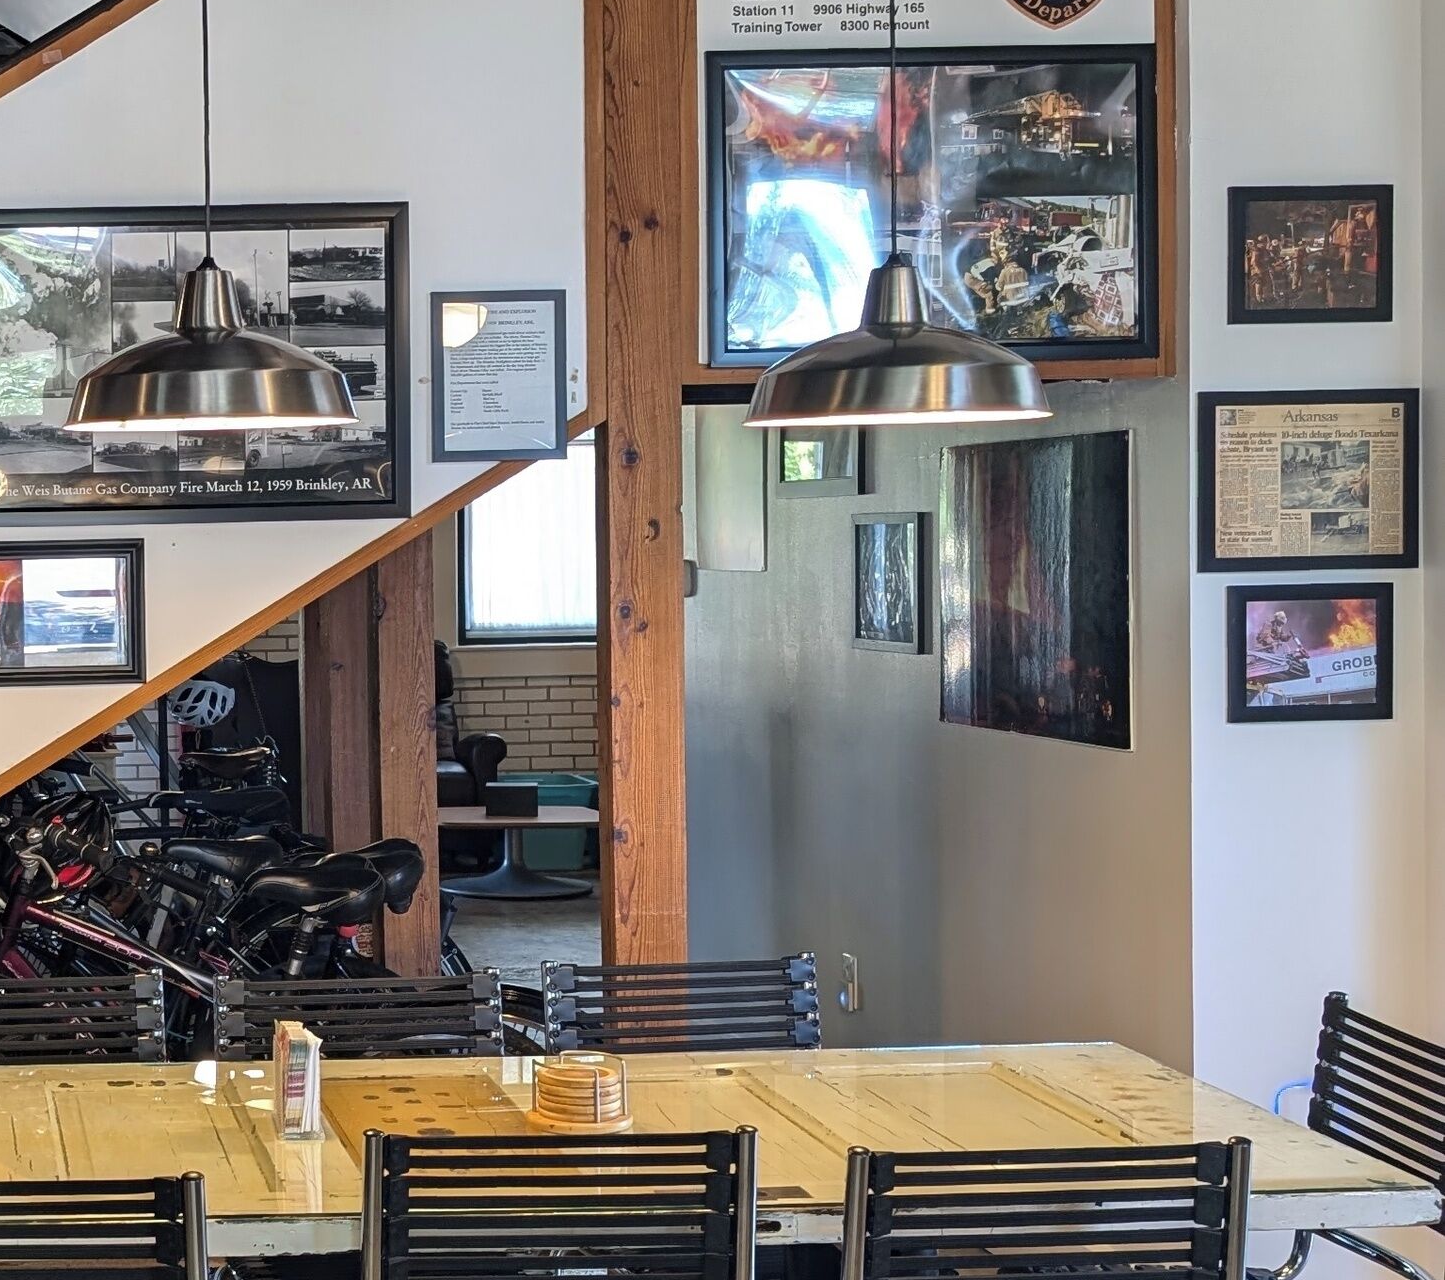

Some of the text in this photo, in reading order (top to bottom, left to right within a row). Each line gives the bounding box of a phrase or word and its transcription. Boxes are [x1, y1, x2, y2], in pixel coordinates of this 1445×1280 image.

[1282, 407, 1400, 423] Arkansas B
[1334, 429, 1358, 438] floods
[1359, 429, 1399, 438] Texarkana
[22, 484, 50, 497] Weis
[53, 484, 92, 496] Butane
[95, 483, 118, 496] Gas
[120, 482, 176, 497] Company
[180, 481, 203, 493] Fire
[206, 480, 243, 493] March
[246, 480, 263, 494] 12,
[267, 480, 293, 492] 1959
[296, 478, 349, 494] Brinkley,
[351, 478, 373, 490] AR
[1332, 654, 1378, 672] GROB
